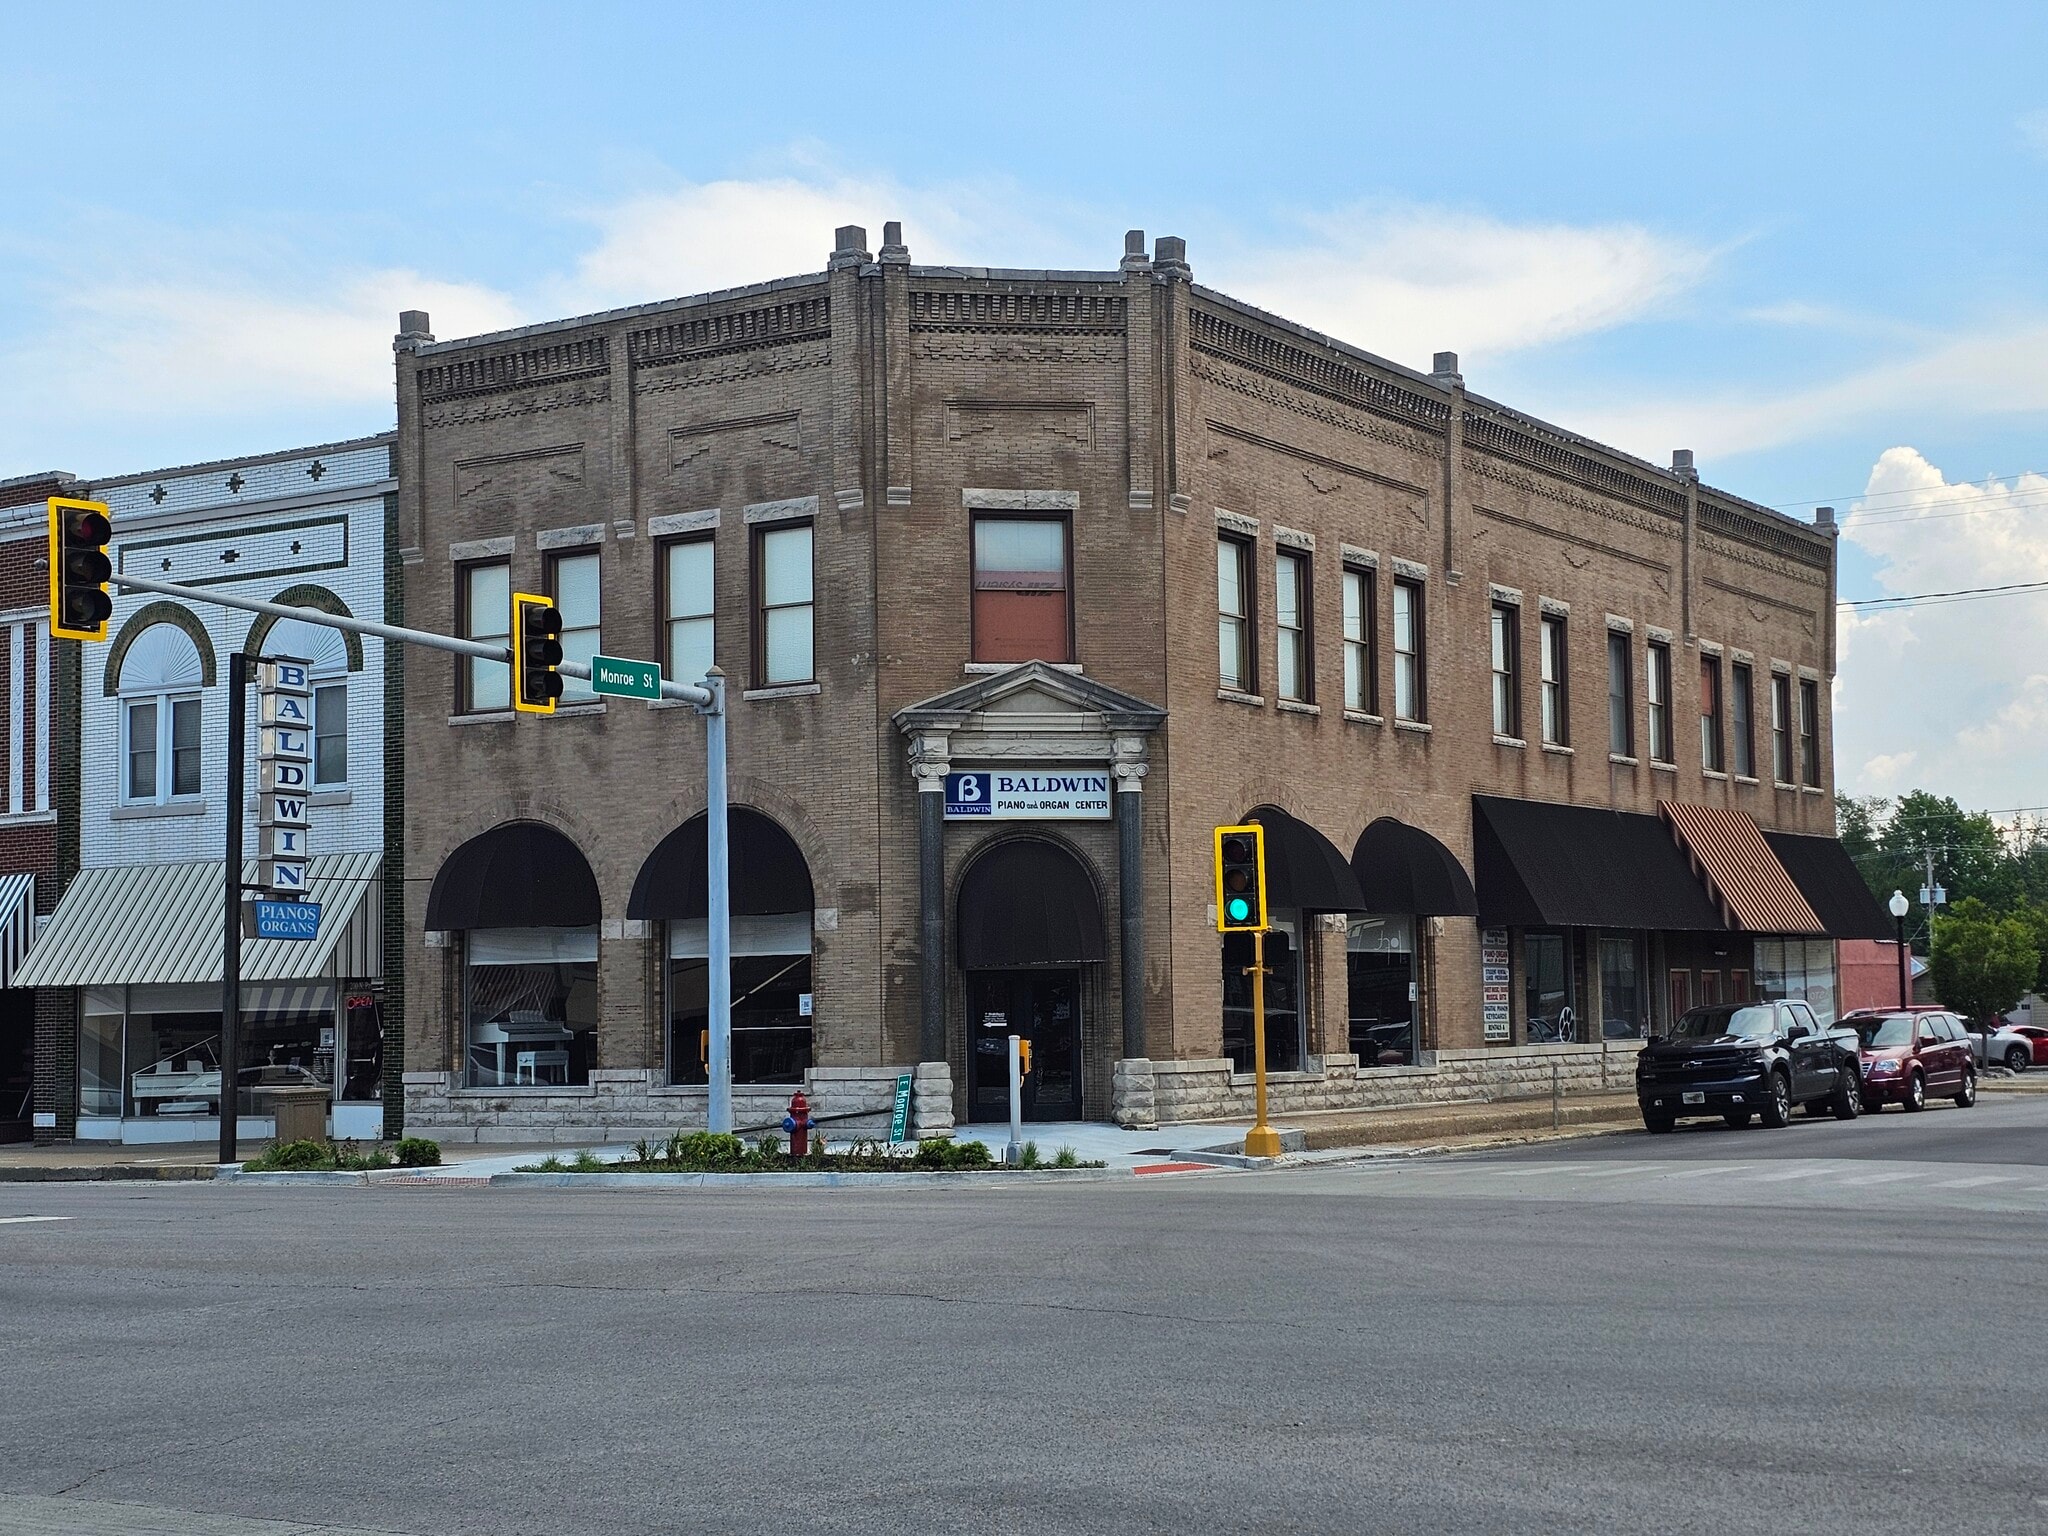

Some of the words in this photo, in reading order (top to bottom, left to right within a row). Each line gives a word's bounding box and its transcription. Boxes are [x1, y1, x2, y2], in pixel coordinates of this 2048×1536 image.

[600, 668, 635, 686] Monroe
[643, 673, 653, 689] St
[276, 665, 306, 886] BALDWIN
[998, 777, 1107, 793] BALDWIN
[946, 806, 991, 814] BALDWIN
[998, 801, 1025, 809] PIANO
[1026, 801, 1038, 809] and
[1039, 801, 1070, 809] ORGAN
[1075, 801, 1108, 809] CENTER
[260, 905, 317, 921] PIANOS
[261, 920, 315, 934] ORGANS
[347, 996, 373, 1009] OPEN
[895, 1089, 909, 1125] Monroe
[894, 1128, 903, 1137] St
